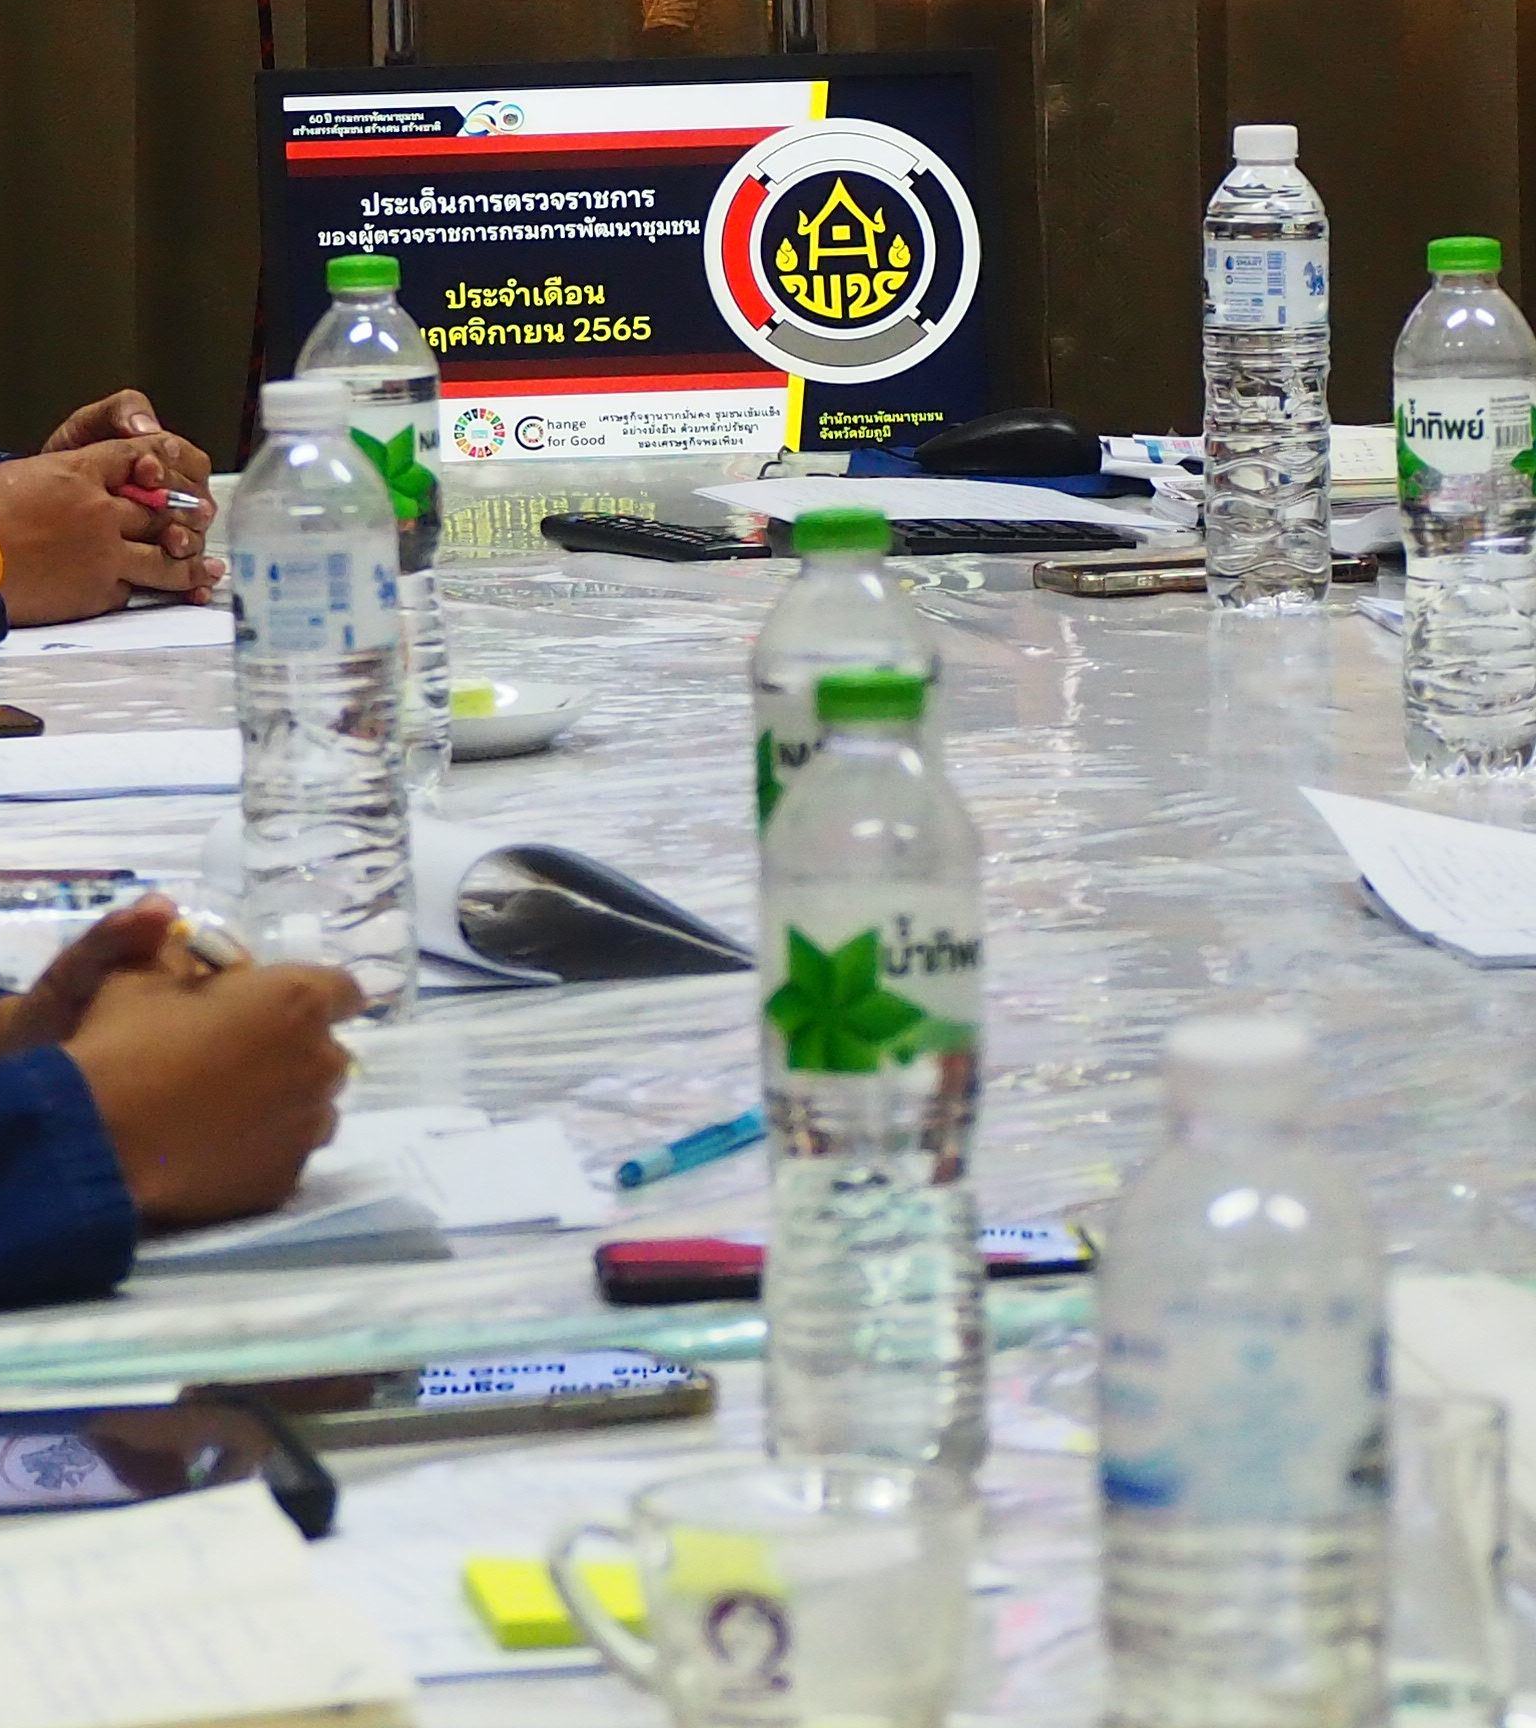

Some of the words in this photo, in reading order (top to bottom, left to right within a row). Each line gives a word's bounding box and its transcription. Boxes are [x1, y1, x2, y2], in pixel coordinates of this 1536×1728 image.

[360, 186, 656, 217] ประเด็นการตรวจราชการ
[317, 217, 701, 253] ของผู้ตรวจราชการกรมการพัฒนาชุมชน
[444, 275, 606, 310] ประจำเดือน
[420, 316, 565, 353] ฤศจิกายน
[573, 316, 653, 343] 2565
[547, 435, 567, 448] for
[570, 434, 606, 448] Good
